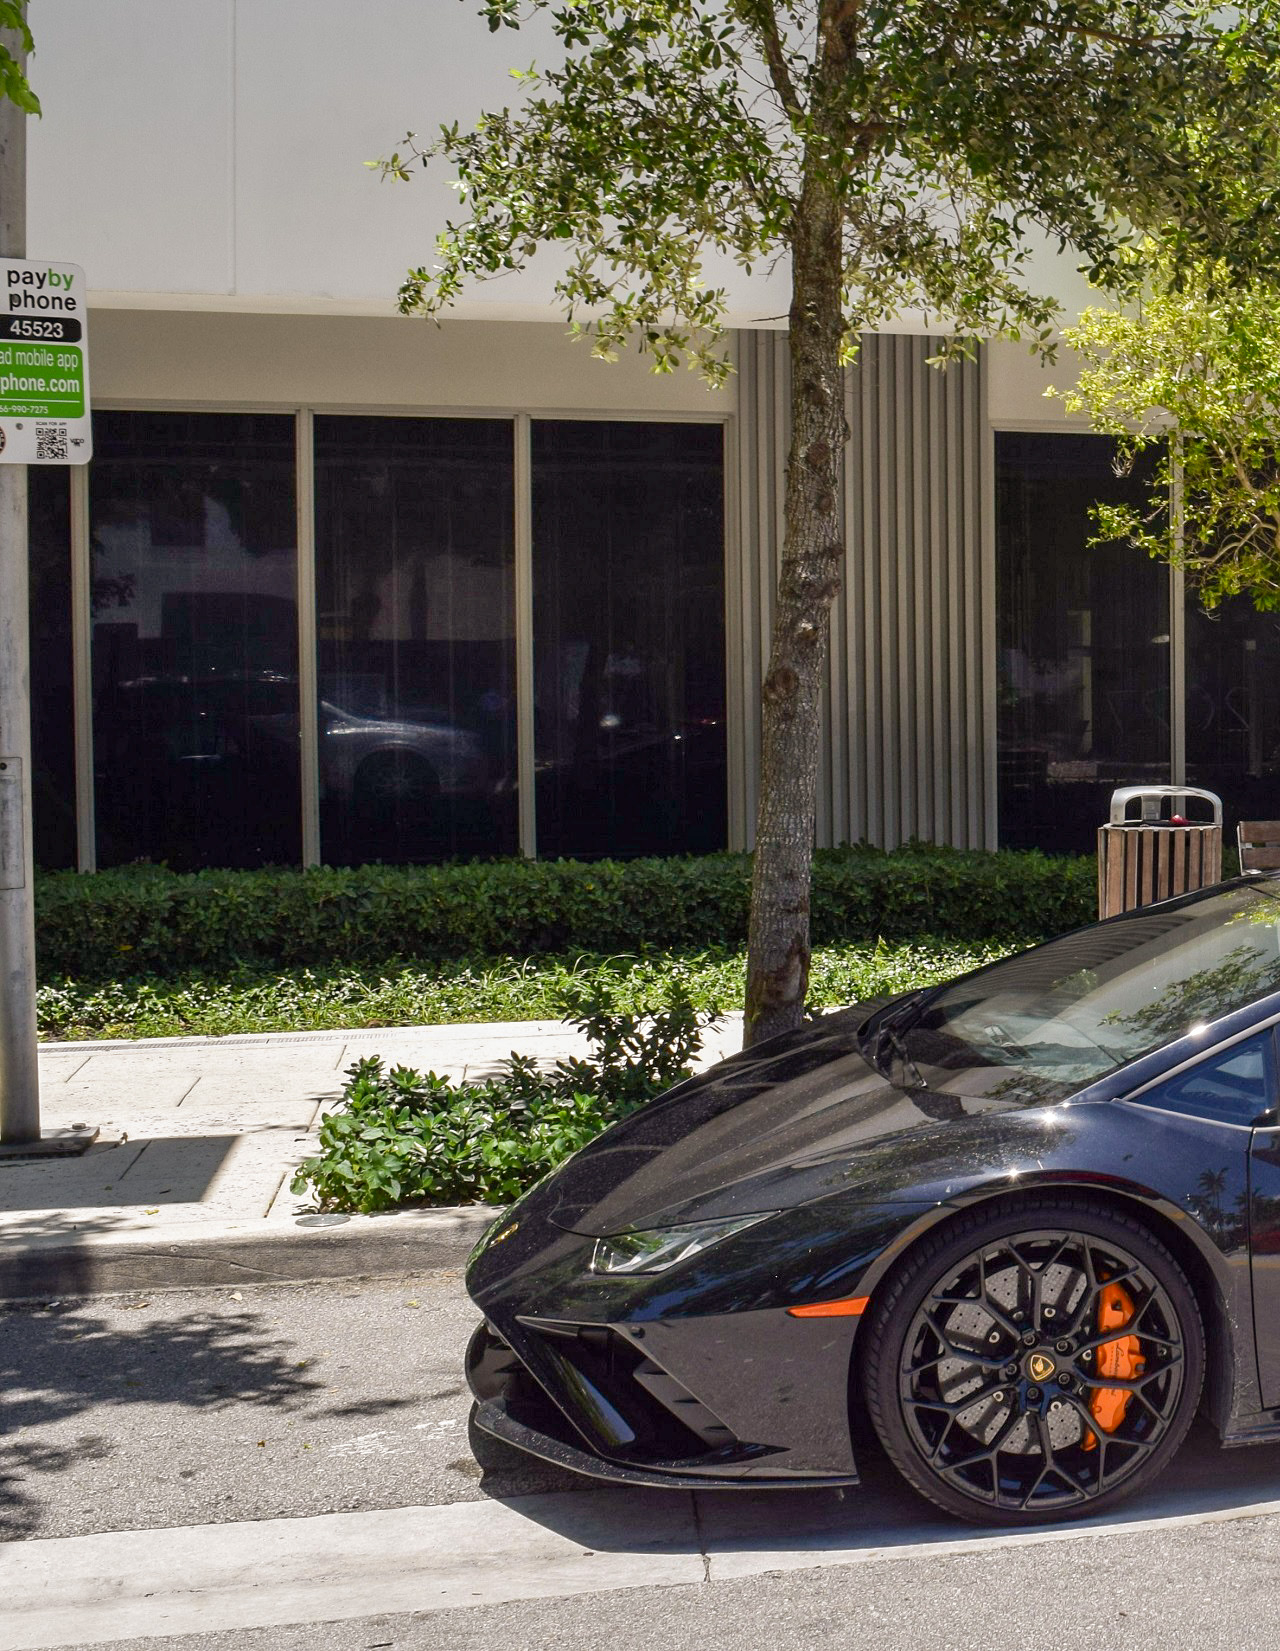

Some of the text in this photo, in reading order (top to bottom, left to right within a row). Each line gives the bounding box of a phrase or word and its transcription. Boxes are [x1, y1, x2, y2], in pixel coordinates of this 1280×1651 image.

[7, 268, 74, 291] payby
[9, 289, 76, 311] phone
[10, 319, 64, 339] 45523
[15, 348, 54, 367] mobile
[57, 353, 78, 371] app
